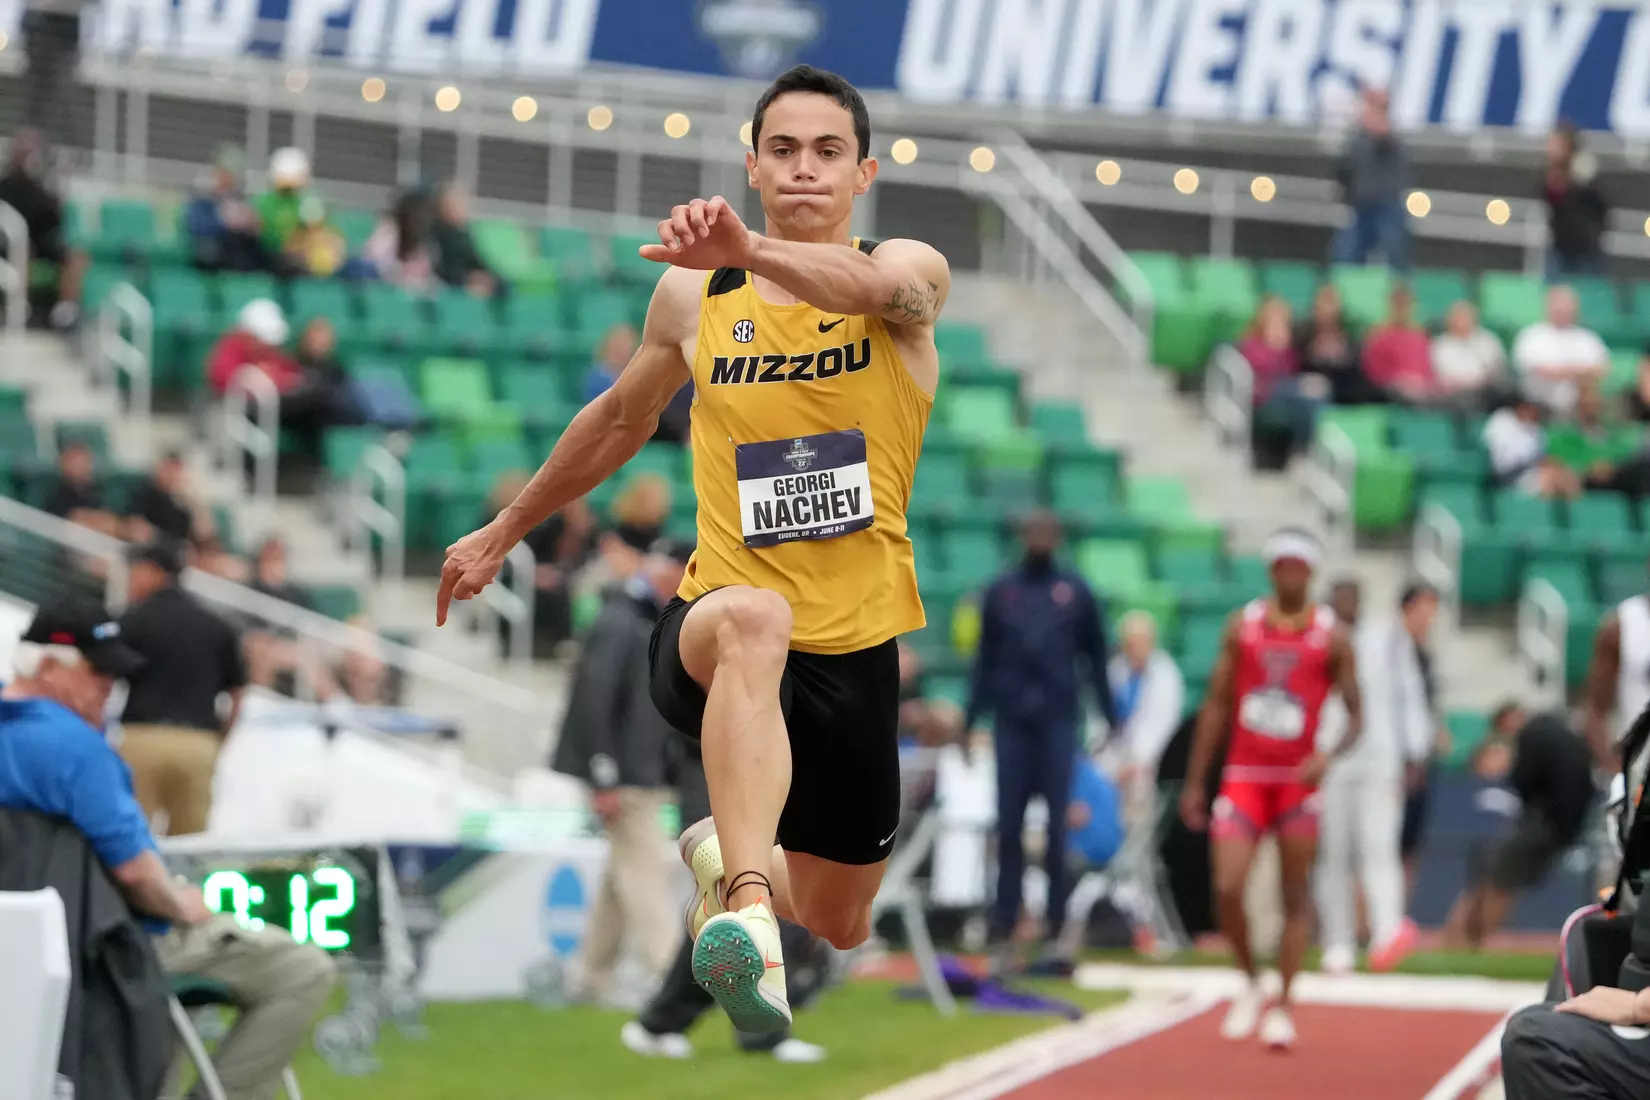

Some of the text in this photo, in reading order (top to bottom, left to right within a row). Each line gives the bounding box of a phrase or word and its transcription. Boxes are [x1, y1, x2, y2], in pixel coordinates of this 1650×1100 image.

[896, 0, 1600, 136] UNIVERSITY
[734, 320, 754, 342] SEC
[710, 337, 871, 385] MIZZOU
[773, 472, 836, 497] GEORGI
[752, 487, 861, 530] NACHEV
[819, 526, 834, 535] JUNE
